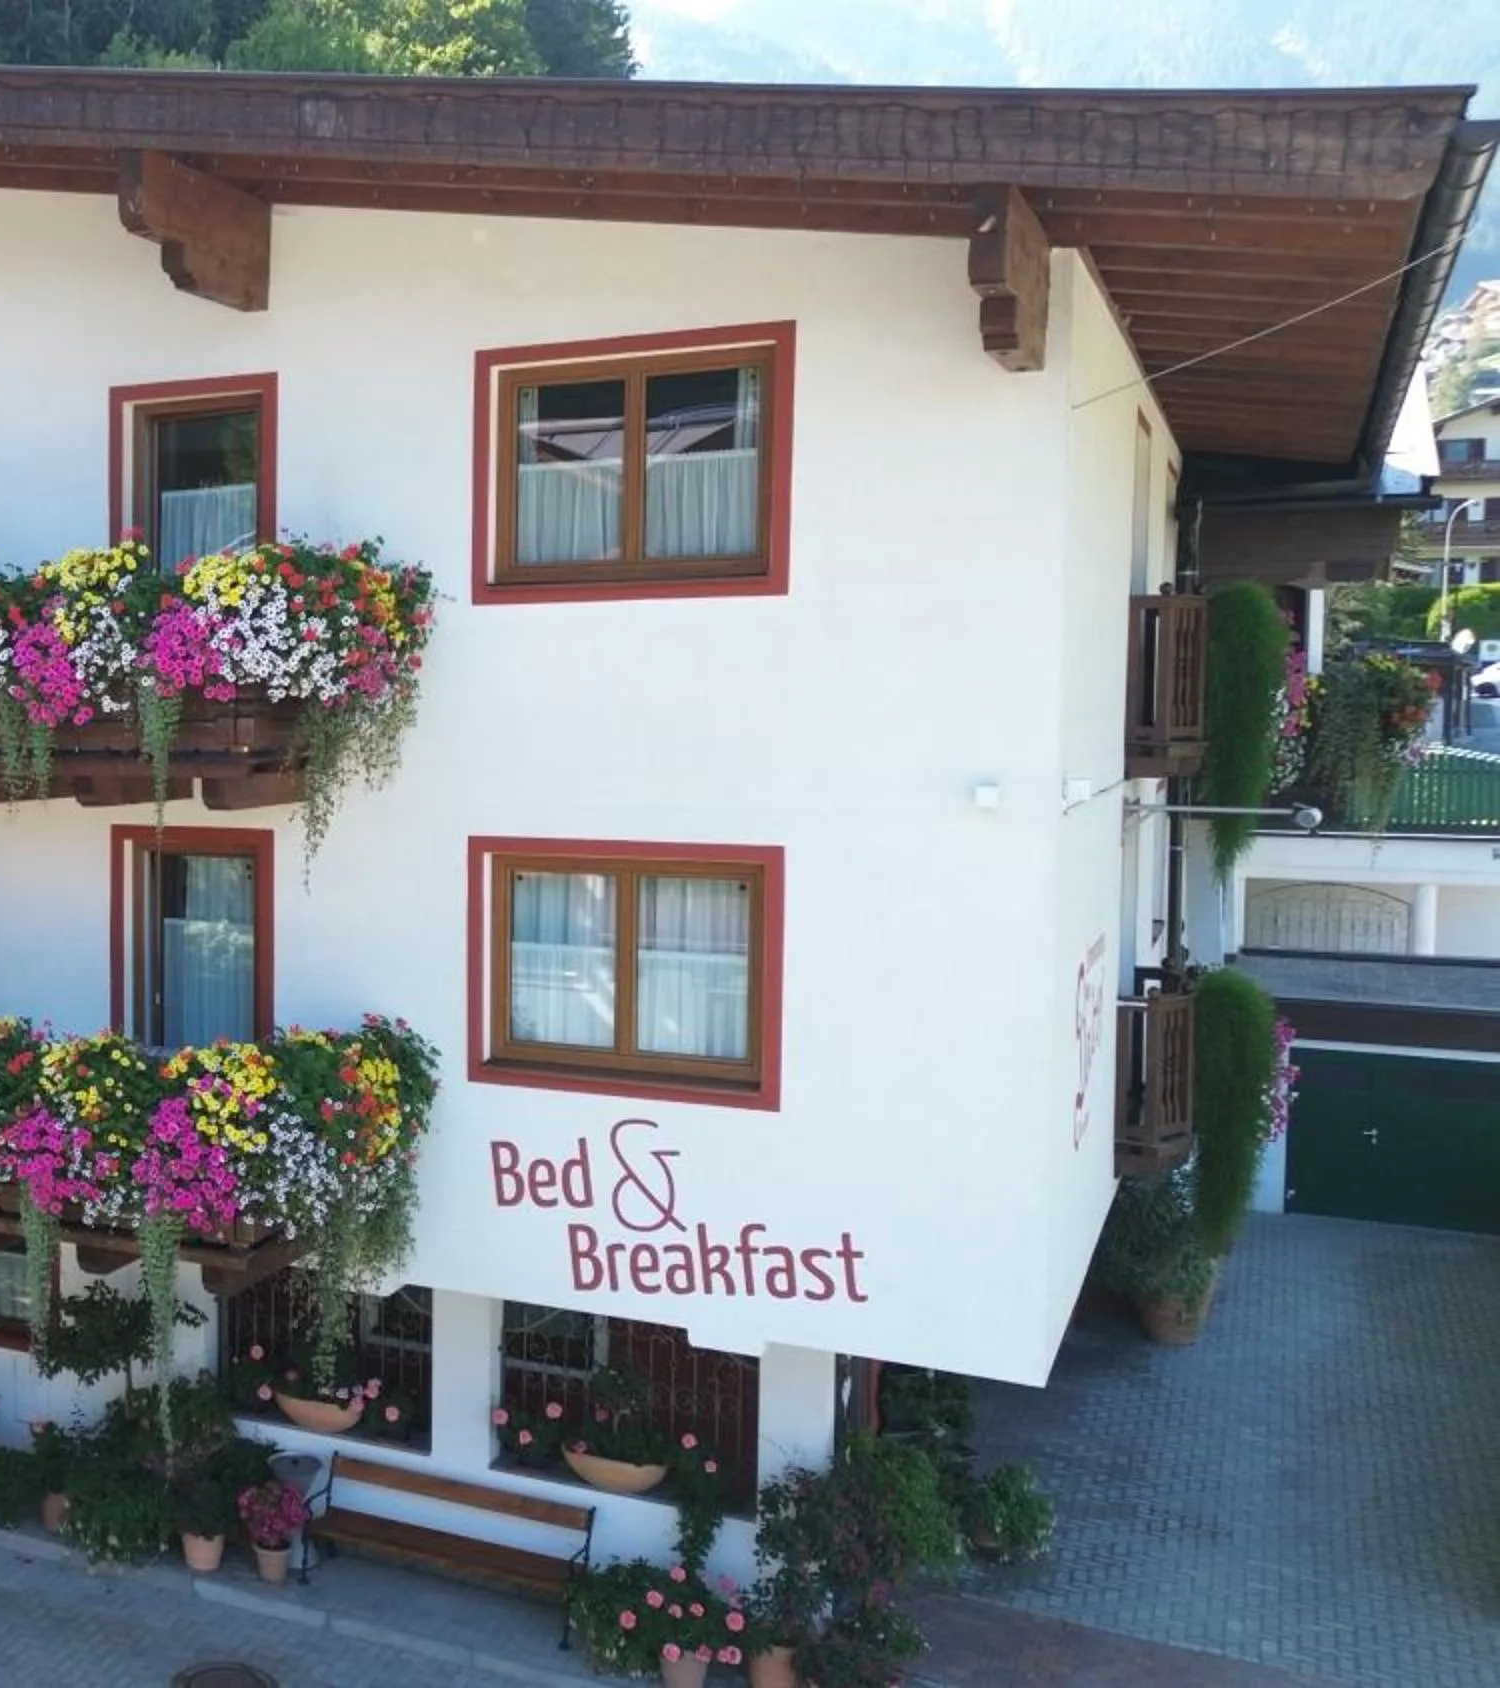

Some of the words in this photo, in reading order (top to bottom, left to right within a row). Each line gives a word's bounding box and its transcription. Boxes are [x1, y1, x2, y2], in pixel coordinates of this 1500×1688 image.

[490, 1137, 594, 1208] Bed
[610, 1118, 687, 1232] &
[567, 1222, 869, 1303] Breakfast
